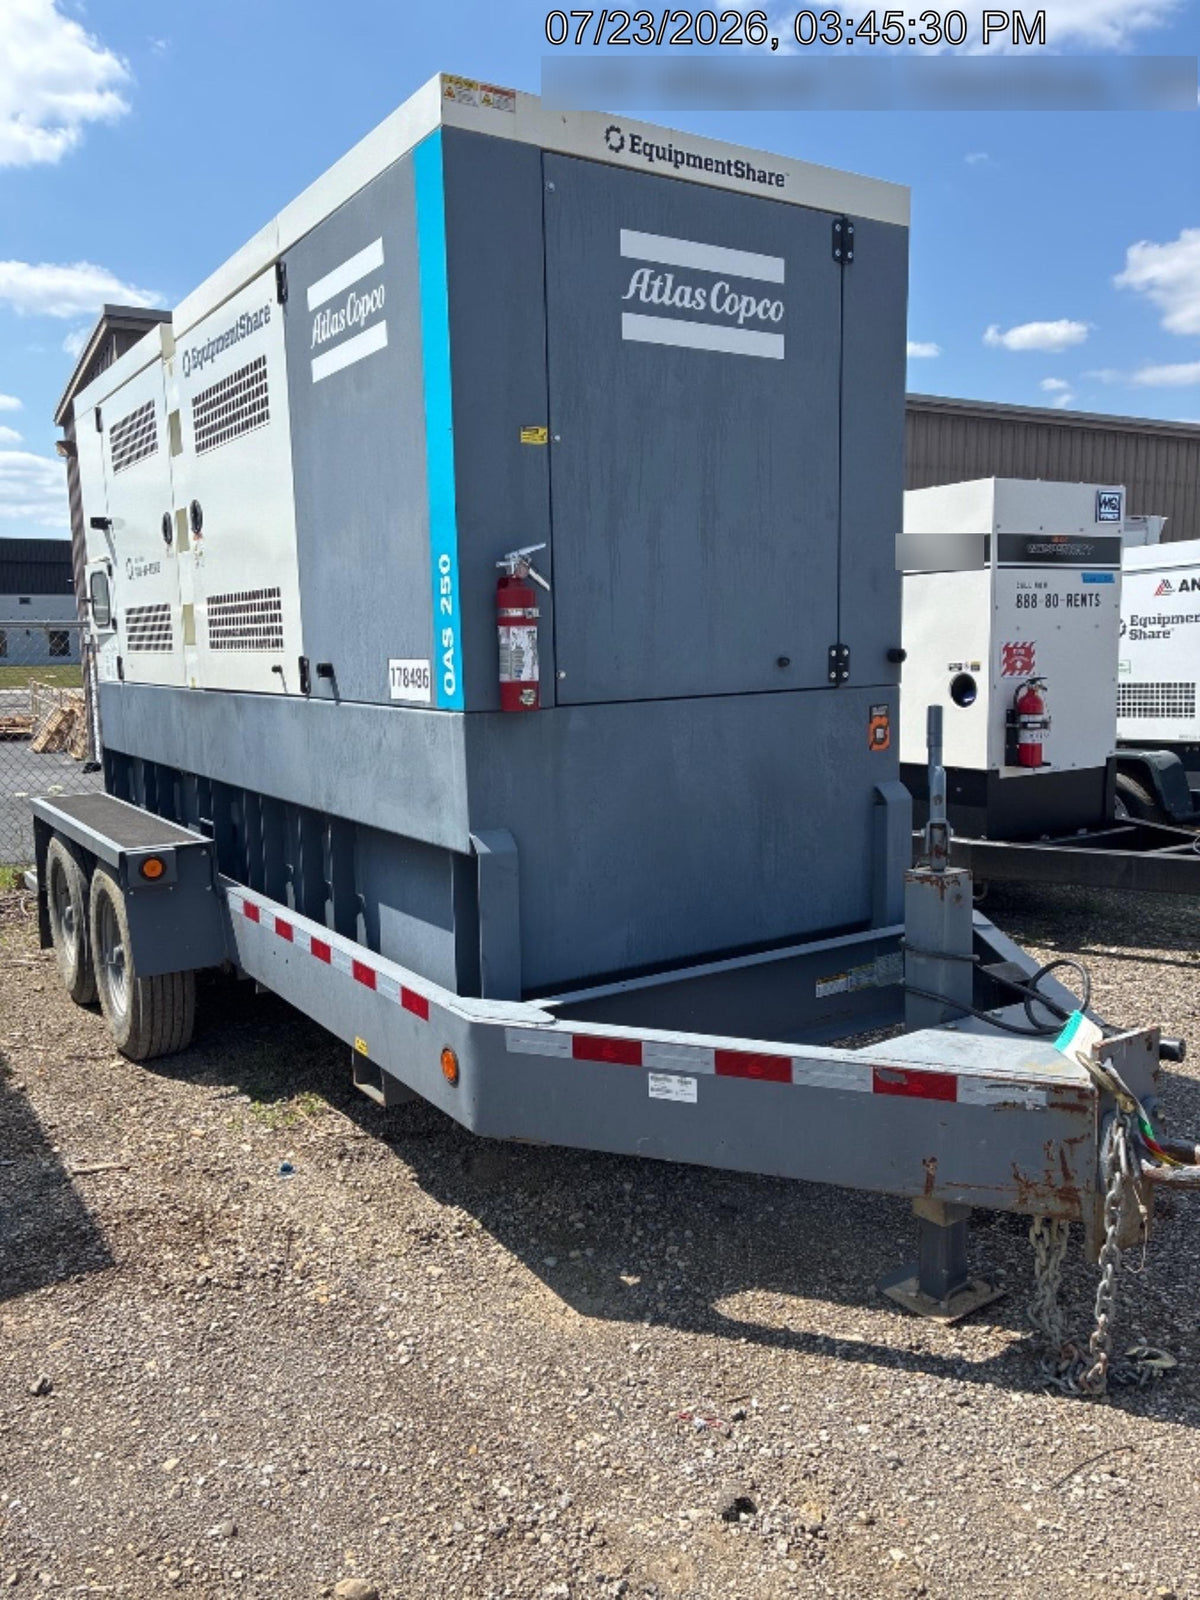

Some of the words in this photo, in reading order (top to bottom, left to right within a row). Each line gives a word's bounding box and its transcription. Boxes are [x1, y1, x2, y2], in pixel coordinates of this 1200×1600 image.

[629, 133, 786, 188] EquipmentShare
[310, 306, 346, 349] Atlas
[347, 284, 386, 327] Copco
[622, 268, 707, 311] Atlas
[710, 281, 785, 324] Copco
[191, 304, 271, 370] EquipmentShare
[438, 554, 453, 616] 250
[1128, 628, 1171, 640] Share
